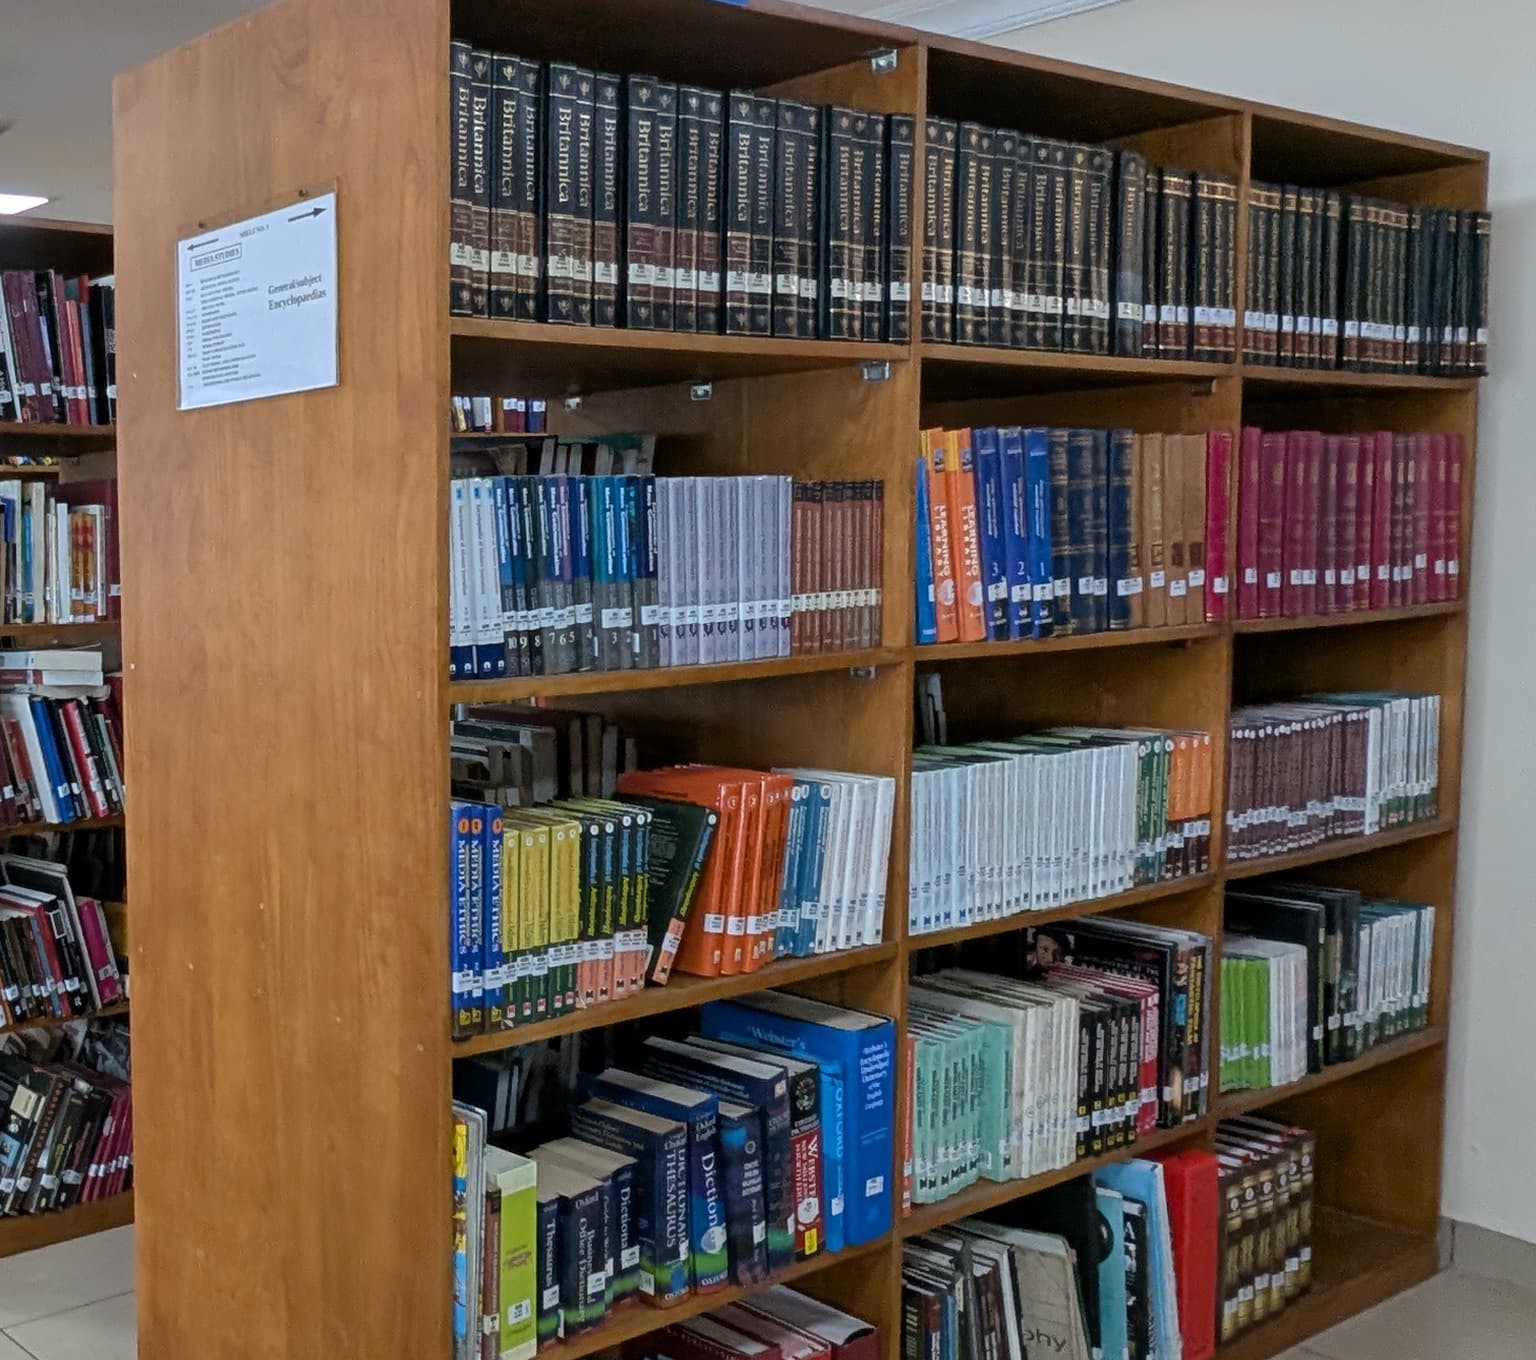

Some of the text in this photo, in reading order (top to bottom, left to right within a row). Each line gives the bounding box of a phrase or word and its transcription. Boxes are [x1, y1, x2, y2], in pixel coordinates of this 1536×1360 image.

[458, 87, 470, 188] Britannica
[473, 96, 488, 194] Britannica
[502, 99, 517, 197] Britannica
[525, 106, 537, 201] Britannica
[558, 108, 572, 203] Britannica
[579, 113, 591, 208] Britannica
[604, 118, 617, 210] Britannica
[637, 120, 652, 212] Britannica
[658, 125, 673, 216] Britannica
[687, 128, 699, 219] Britannica
[706, 132, 720, 221] Britannica
[737, 133, 751, 222] Britannica
[757, 136, 771, 225] Britannica
[784, 141, 796, 228] Britannica
[852, 150, 864, 235] Britannica
[899, 153, 911, 236] Britannica
[268, 273, 322, 295] General subject
[938, 505, 950, 576] LEARNING
[992, 562, 998, 576] 3
[1018, 561, 1024, 575] 2
[1040, 562, 1045, 576] 1
[508, 637, 517, 649] 10
[520, 636, 528, 648] 9
[549, 632, 555, 644] 7
[560, 634, 566, 645] 6
[569, 631, 575, 642] 5
[612, 632, 618, 644] 3
[458, 840, 466, 893] MEDIA
[471, 840, 479, 953] MEDIA ETHICS
[492, 839, 500, 953] MEDIA ETHICS
[621, 1186, 631, 1249] Dictiona
[666, 1149, 677, 1248] THESAURUS
[677, 1148, 689, 1245] DICTIONAR
[701, 1152, 719, 1228] Diction
[546, 1218, 556, 1287] Thesaurus
[577, 1217, 587, 1322] Office Dictionary
